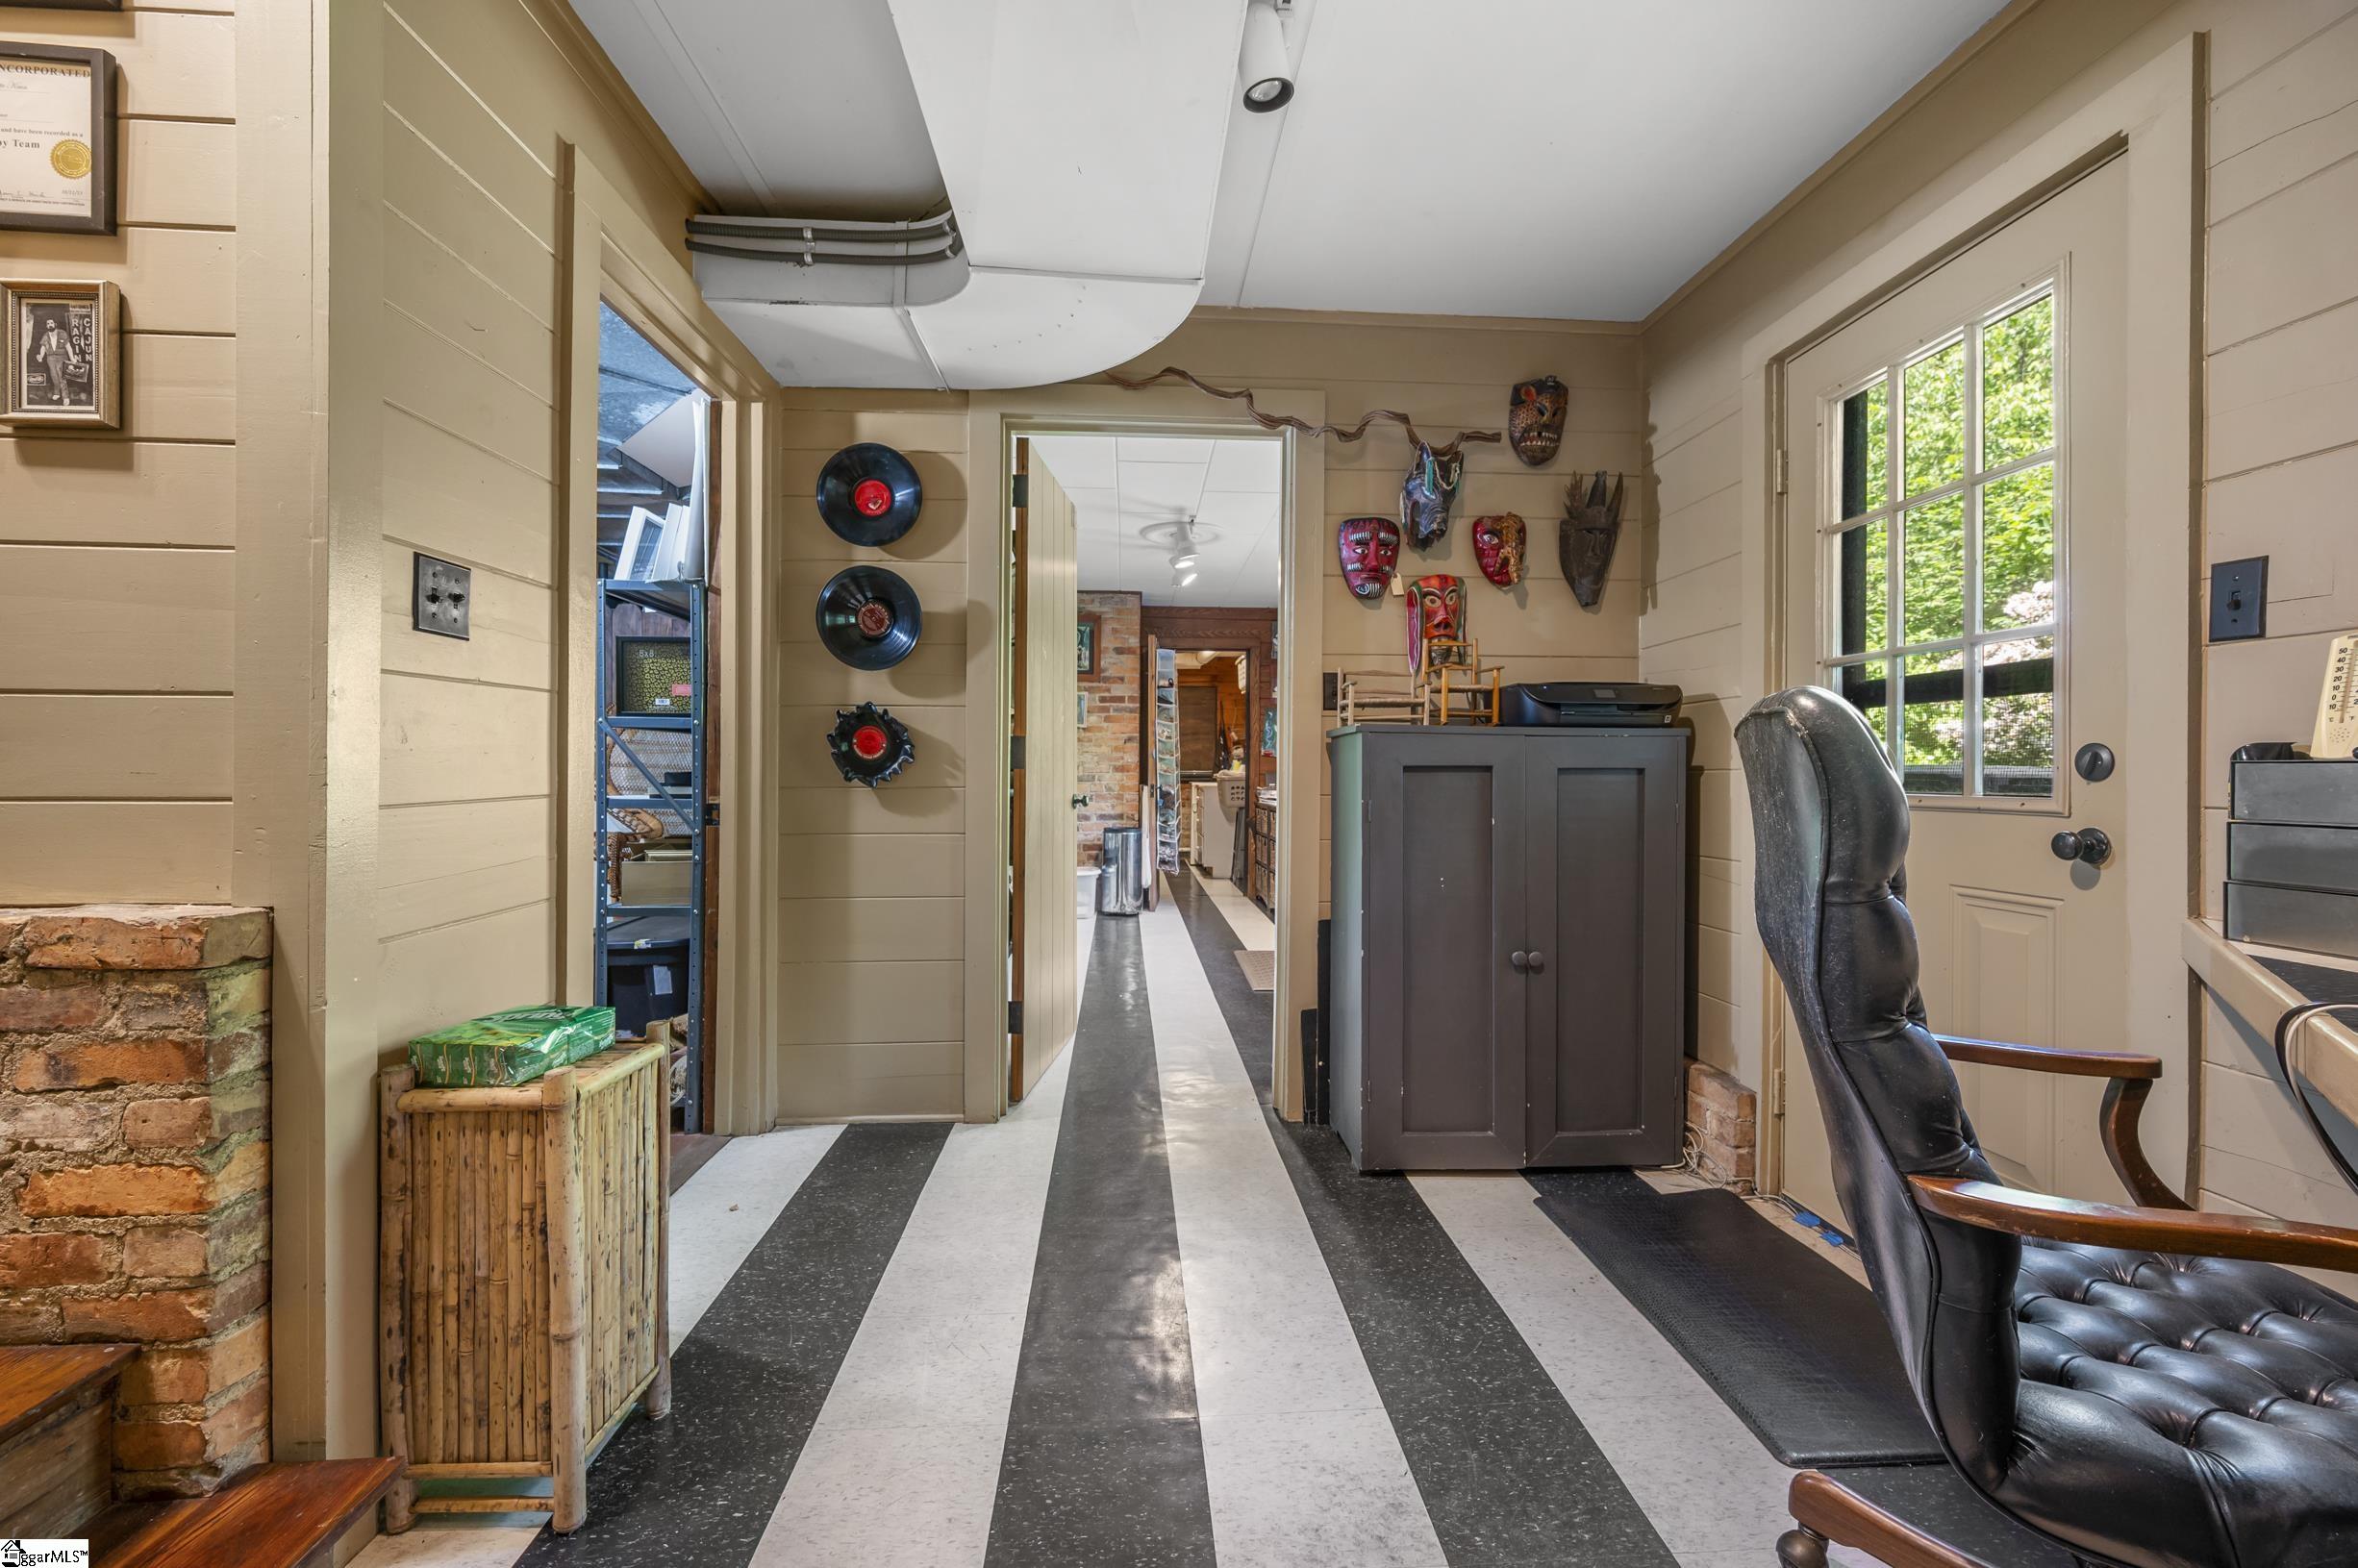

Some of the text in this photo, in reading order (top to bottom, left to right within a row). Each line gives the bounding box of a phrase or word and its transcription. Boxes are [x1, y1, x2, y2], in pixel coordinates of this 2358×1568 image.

[13, 139, 40, 148] Team
[72, 319, 81, 361] RAGIN
[84, 318, 92, 361] CAJUN
